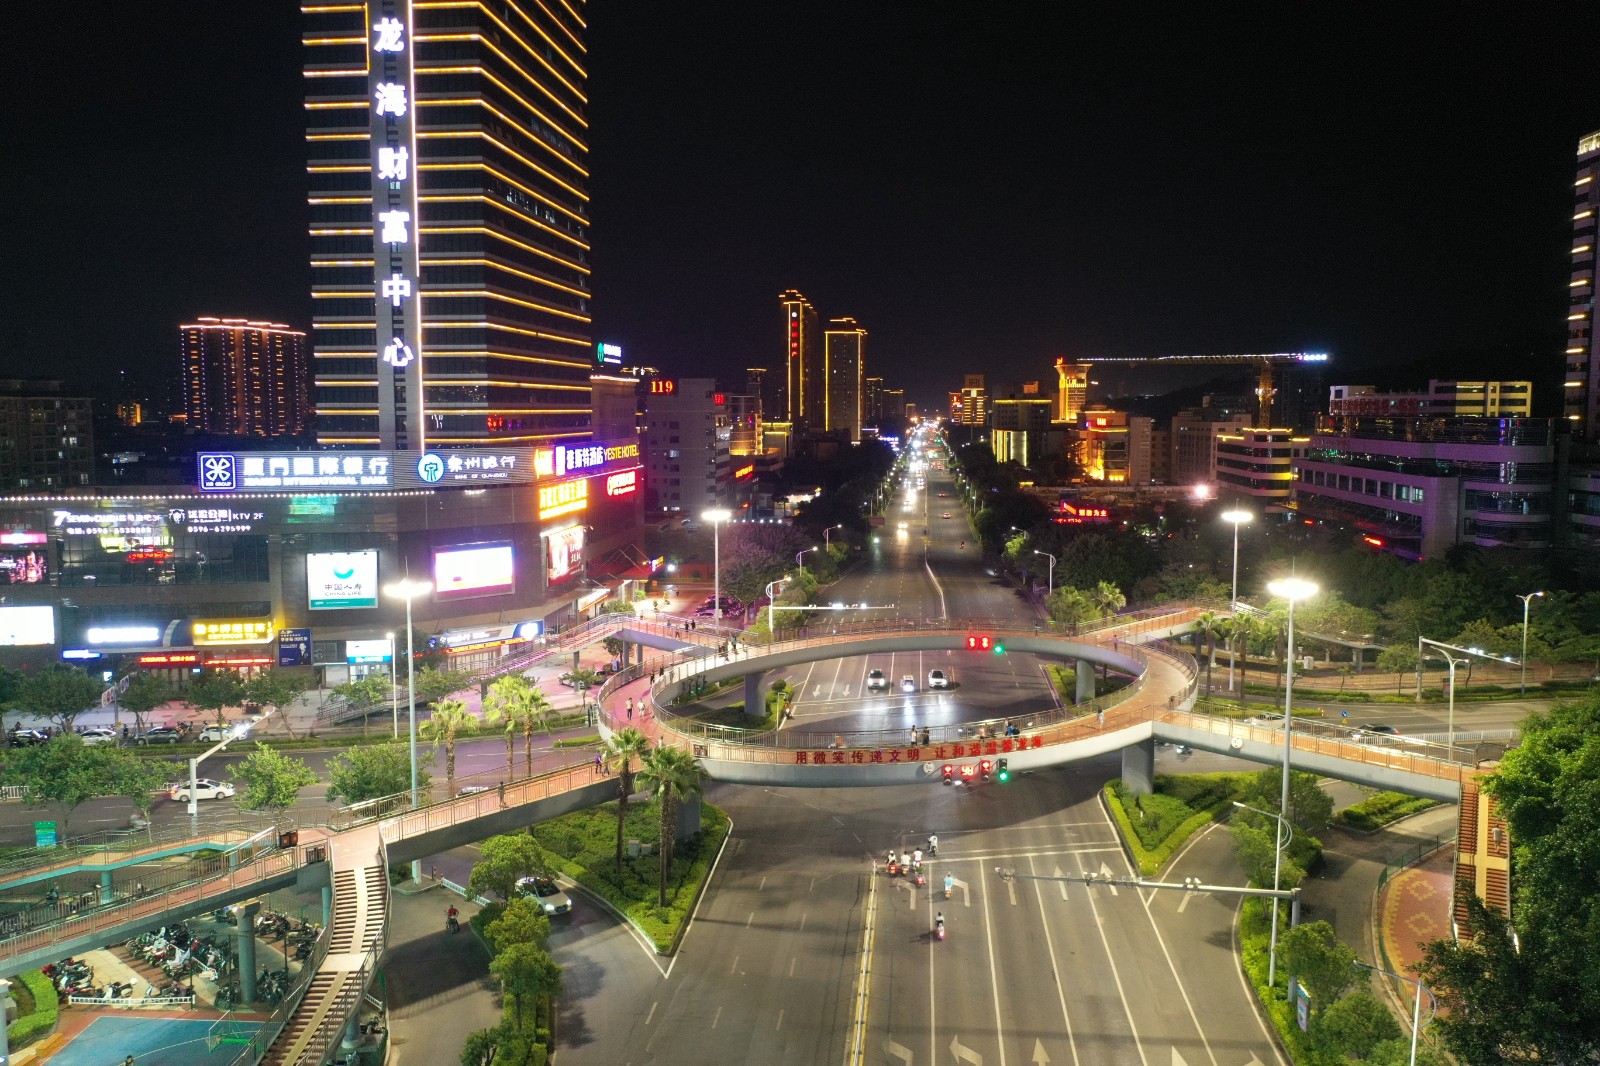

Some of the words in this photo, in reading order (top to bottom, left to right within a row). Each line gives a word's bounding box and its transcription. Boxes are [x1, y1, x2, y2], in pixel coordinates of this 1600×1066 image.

[651, 380, 674, 393] 119
[603, 447, 622, 461] YESTE
[622, 444, 640, 458] HOTEL
[253, 512, 264, 520] 2F
[187, 525, 252, 533] 0596-6295999
[796, 748, 920, 765] 用微笑传递文明
